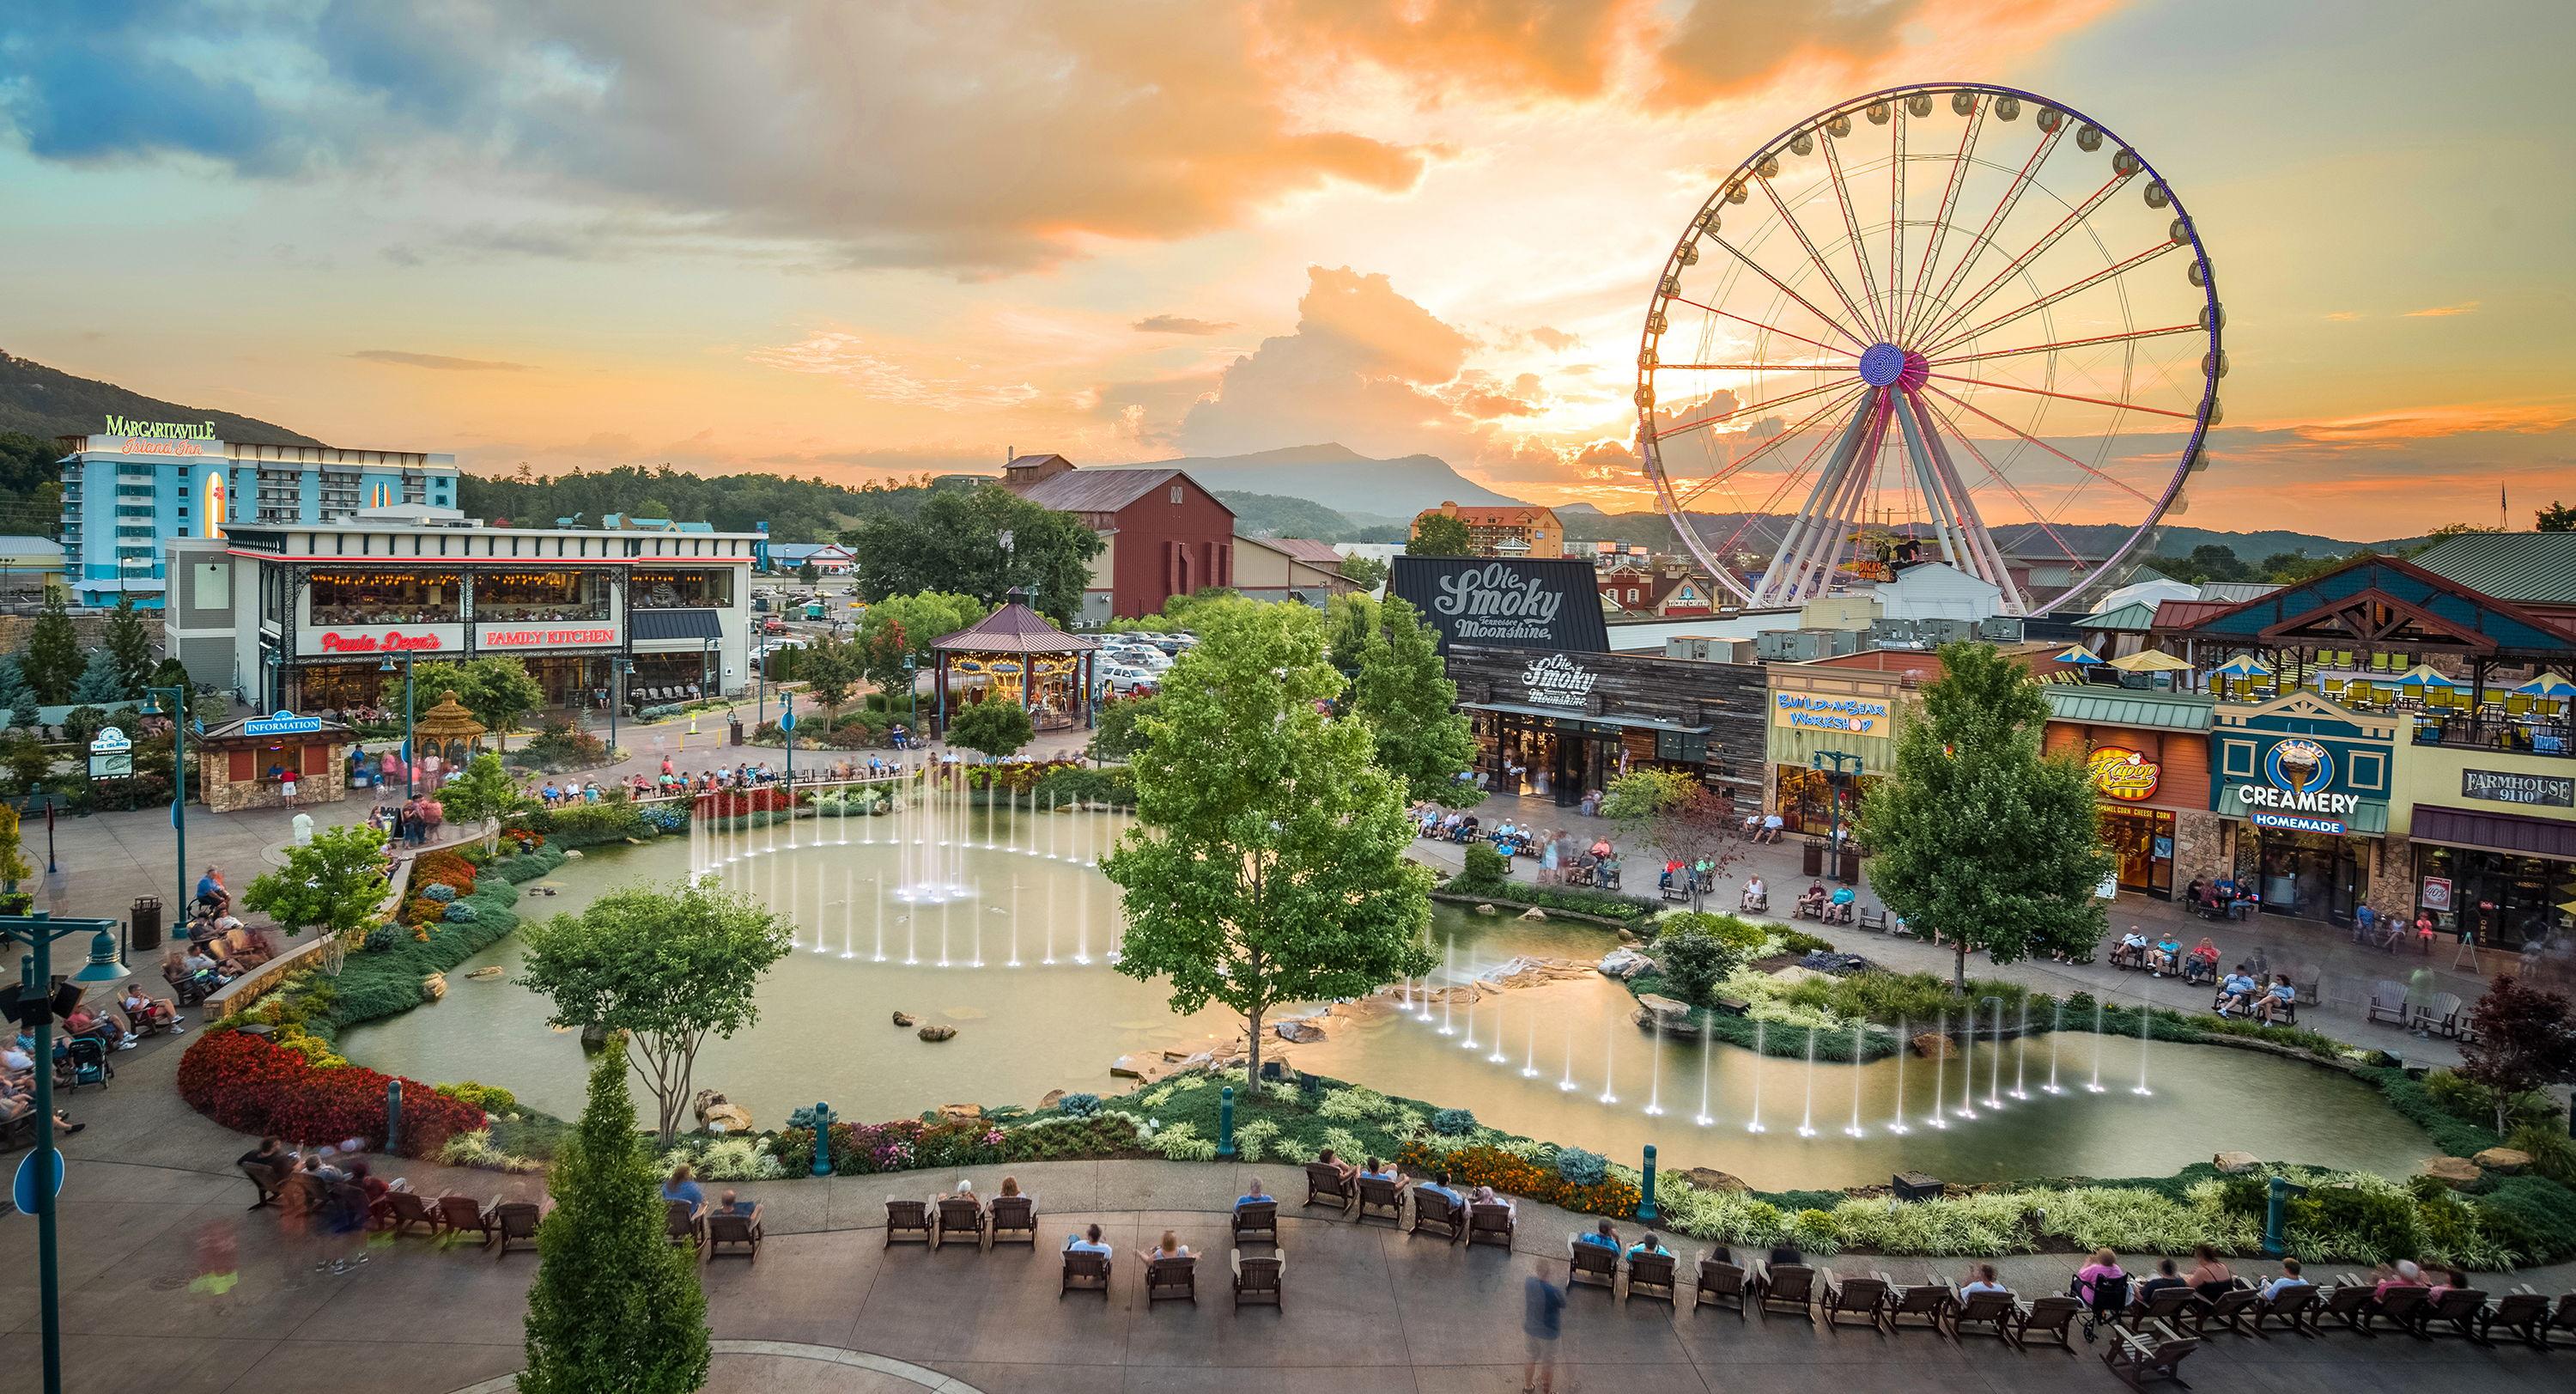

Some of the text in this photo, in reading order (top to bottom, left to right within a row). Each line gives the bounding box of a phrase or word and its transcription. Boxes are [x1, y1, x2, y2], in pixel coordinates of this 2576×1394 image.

[106, 414, 216, 441] MARGARITAVILLE
[121, 436, 204, 457] Island Inn
[1483, 563, 1527, 590] Ole
[1434, 569, 1563, 624] Smoky
[1455, 619, 1552, 640] Moonshine
[1479, 615, 1518, 626] Tennessee
[321, 631, 442, 653] Paula Deen's
[485, 629, 614, 645] FAMILY KITCHEN
[1551, 654, 1575, 673] Ole
[1522, 657, 1598, 696] Smoky
[1528, 688, 1587, 707] Moonshine
[248, 721, 319, 732] INFORMATION
[1789, 712, 1874, 733] WORKSHOP
[2275, 741, 2324, 758] ISLAND
[2466, 773, 2570, 800] FARMHOUSE
[2500, 789, 2534, 802] 9110
[2239, 785, 2359, 814] CREAMERY
[2117, 807, 2131, 815] CORN
[2257, 814, 2340, 833] HOMEMADE
[2427, 886, 2445, 898] 40%
